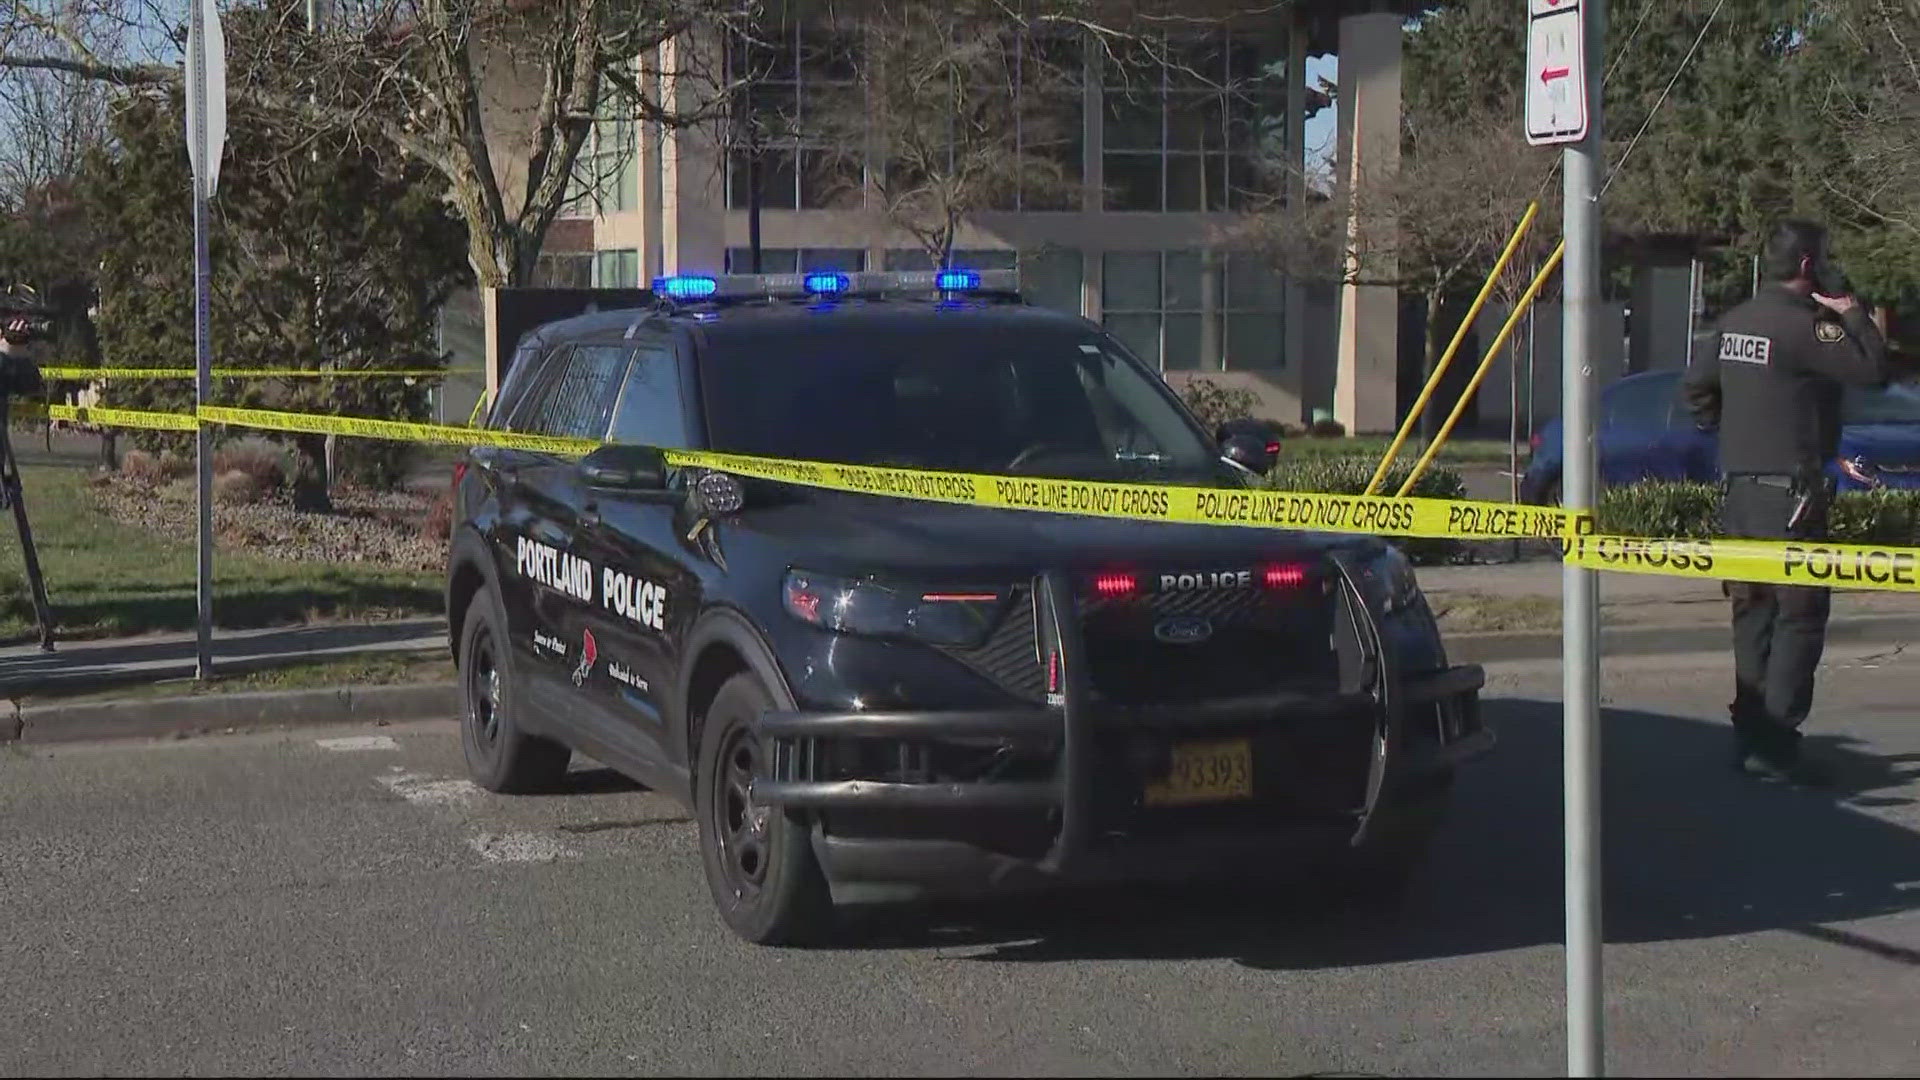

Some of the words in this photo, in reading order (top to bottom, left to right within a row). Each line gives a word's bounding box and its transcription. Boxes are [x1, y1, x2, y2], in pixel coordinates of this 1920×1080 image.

[1719, 336, 1766, 360] POLICE
[895, 472, 913, 494] DO
[913, 475, 935, 496] NOT
[936, 476, 976, 500] CROSS
[996, 480, 1040, 506] POLICE
[1041, 483, 1068, 509] LINE
[1071, 486, 1090, 510] DO
[1092, 487, 1120, 513] NOT
[1121, 489, 1169, 516] CROSS
[1196, 493, 1249, 521] POLICE
[1251, 496, 1286, 522] LINE
[1288, 498, 1314, 524] DO
[1316, 500, 1351, 527] NOT
[1352, 501, 1415, 531] CROSS
[1448, 506, 1518, 535] POLICE
[1521, 512, 1566, 537] LINE
[1575, 514, 1596, 537] D
[1597, 537, 1714, 572] CROSS
[1784, 545, 1916, 584] POLICE
[517, 535, 593, 602] PORTLAND
[602, 567, 667, 630] POLICE
[1160, 570, 1251, 592] POLICE
